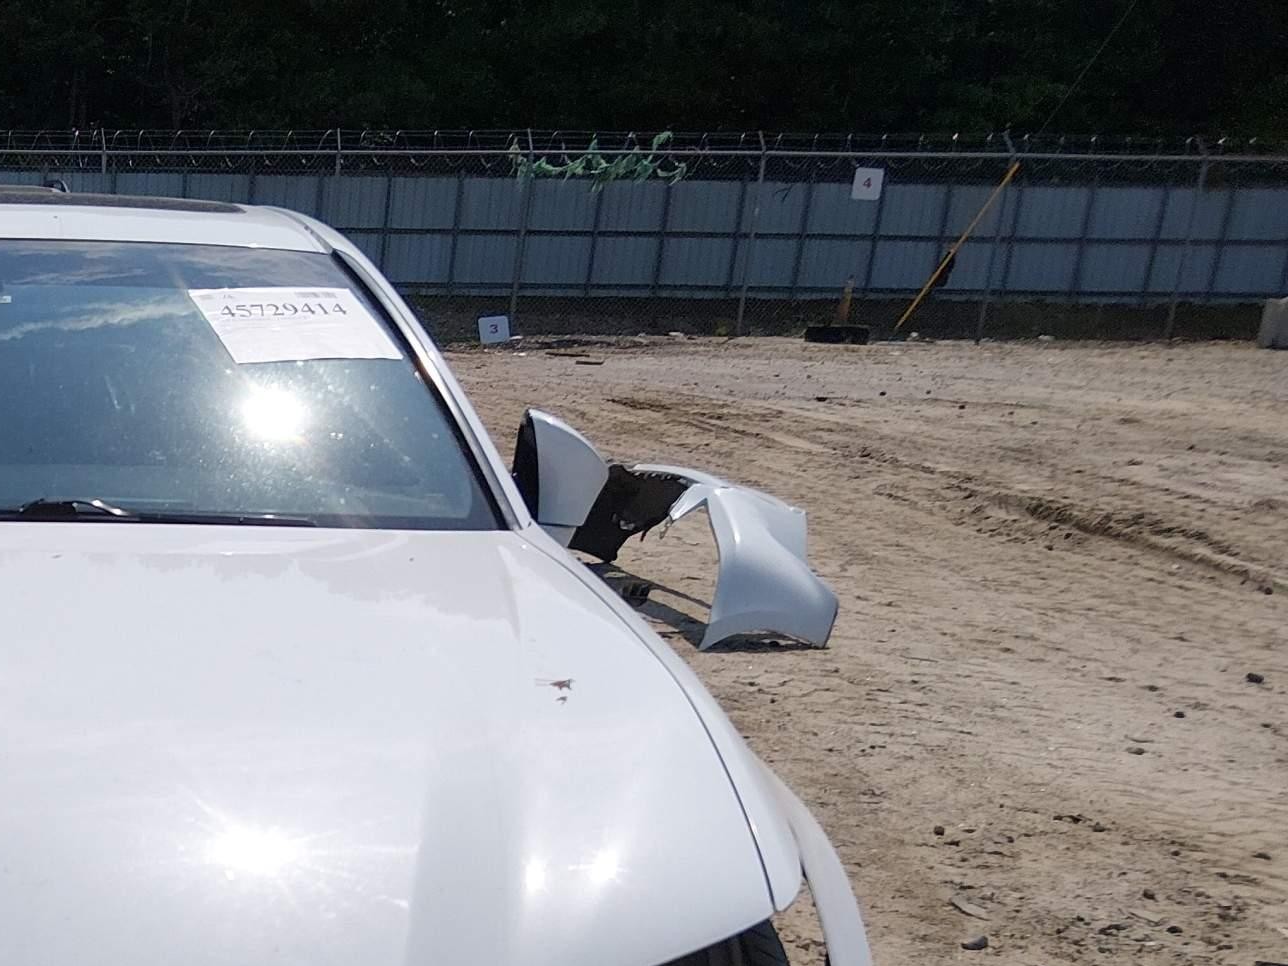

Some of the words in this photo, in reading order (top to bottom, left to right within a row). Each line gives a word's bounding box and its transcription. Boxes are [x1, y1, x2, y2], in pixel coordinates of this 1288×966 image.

[862, 176, 872, 188] 4
[221, 303, 347, 318] 45729414
[489, 324, 498, 335] 3
